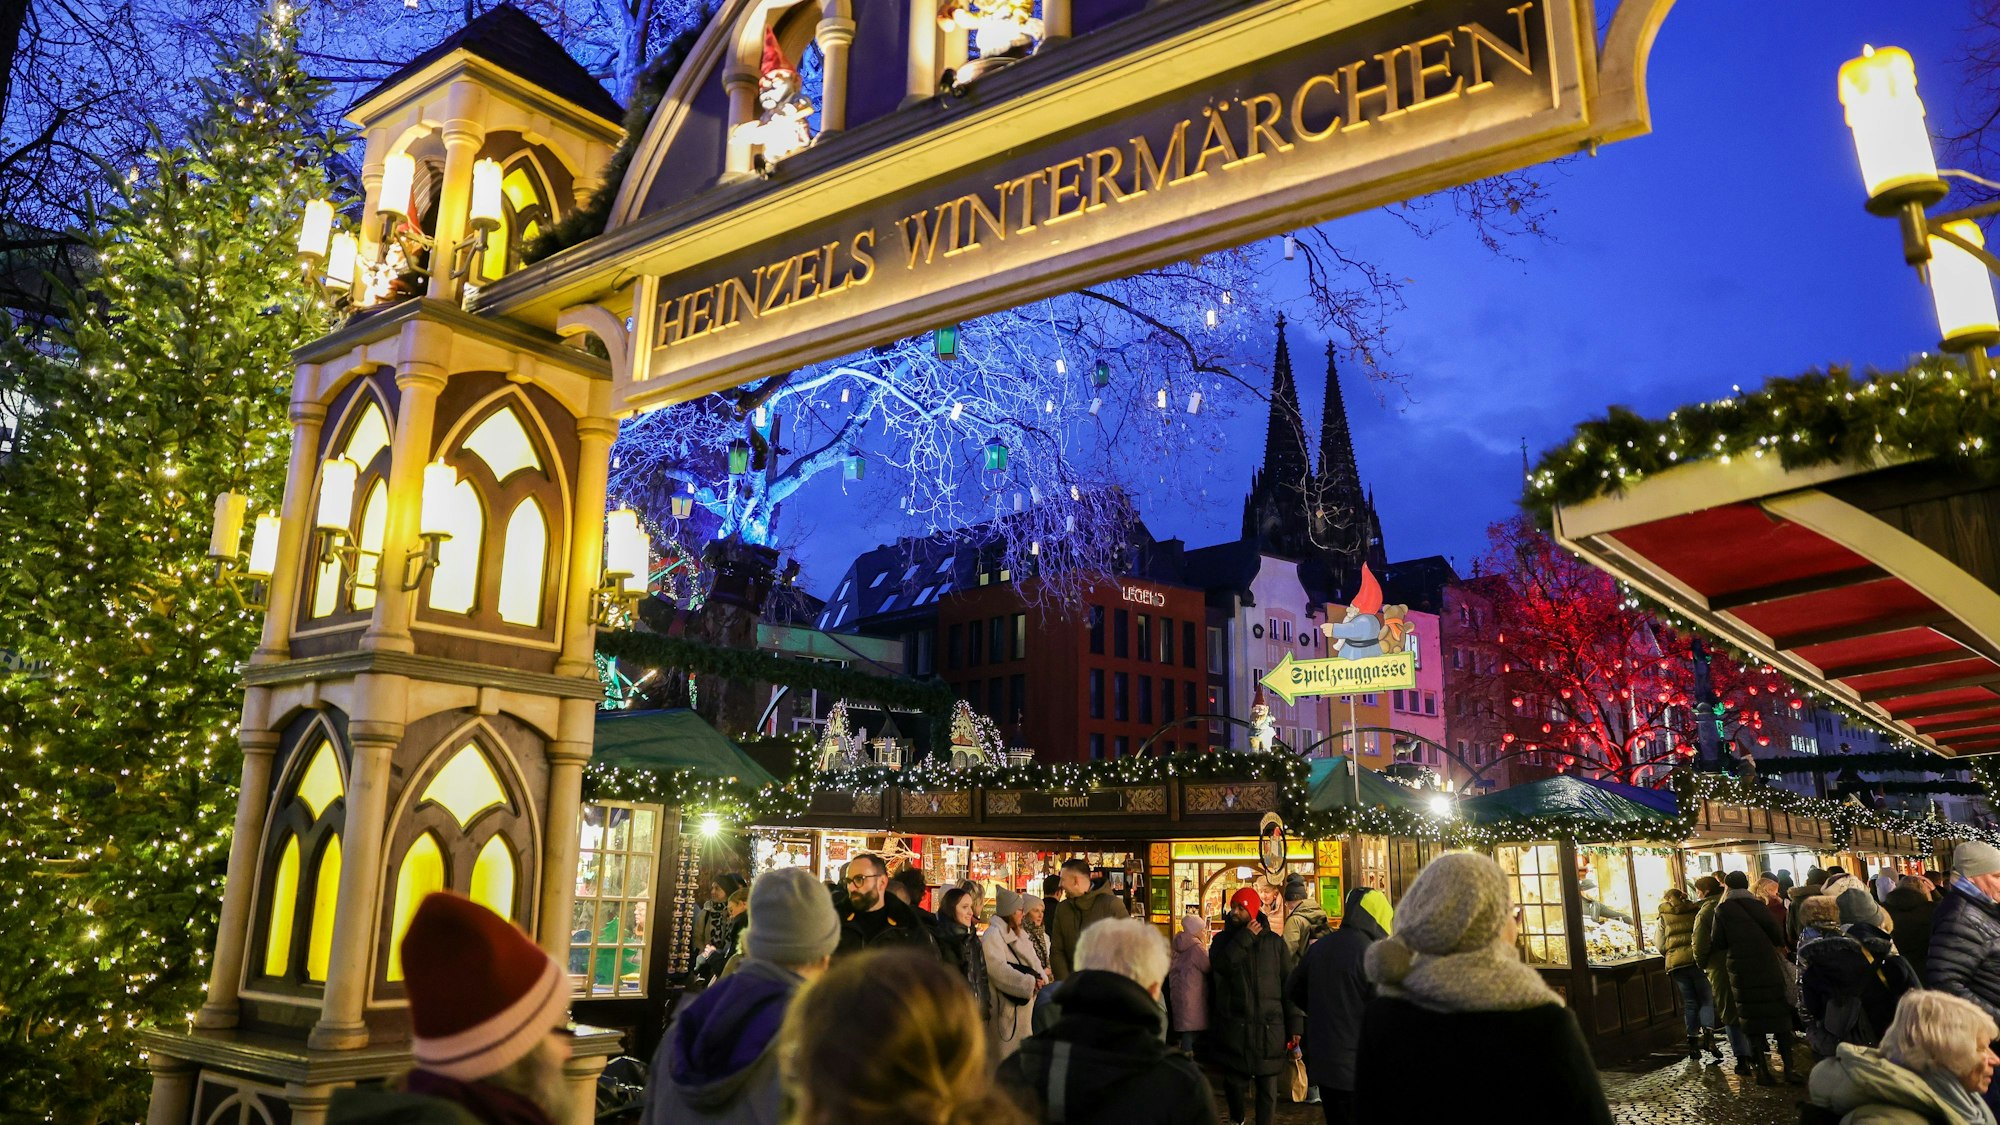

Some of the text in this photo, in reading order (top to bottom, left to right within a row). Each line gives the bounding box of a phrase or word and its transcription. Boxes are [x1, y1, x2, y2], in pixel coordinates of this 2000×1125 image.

[655, 2, 1533, 348] HEINZELS WINTERMÄRCHEN
[1291, 661, 1406, 687] Spielzeuggasse
[1053, 797, 1089, 807] POSTAMT
